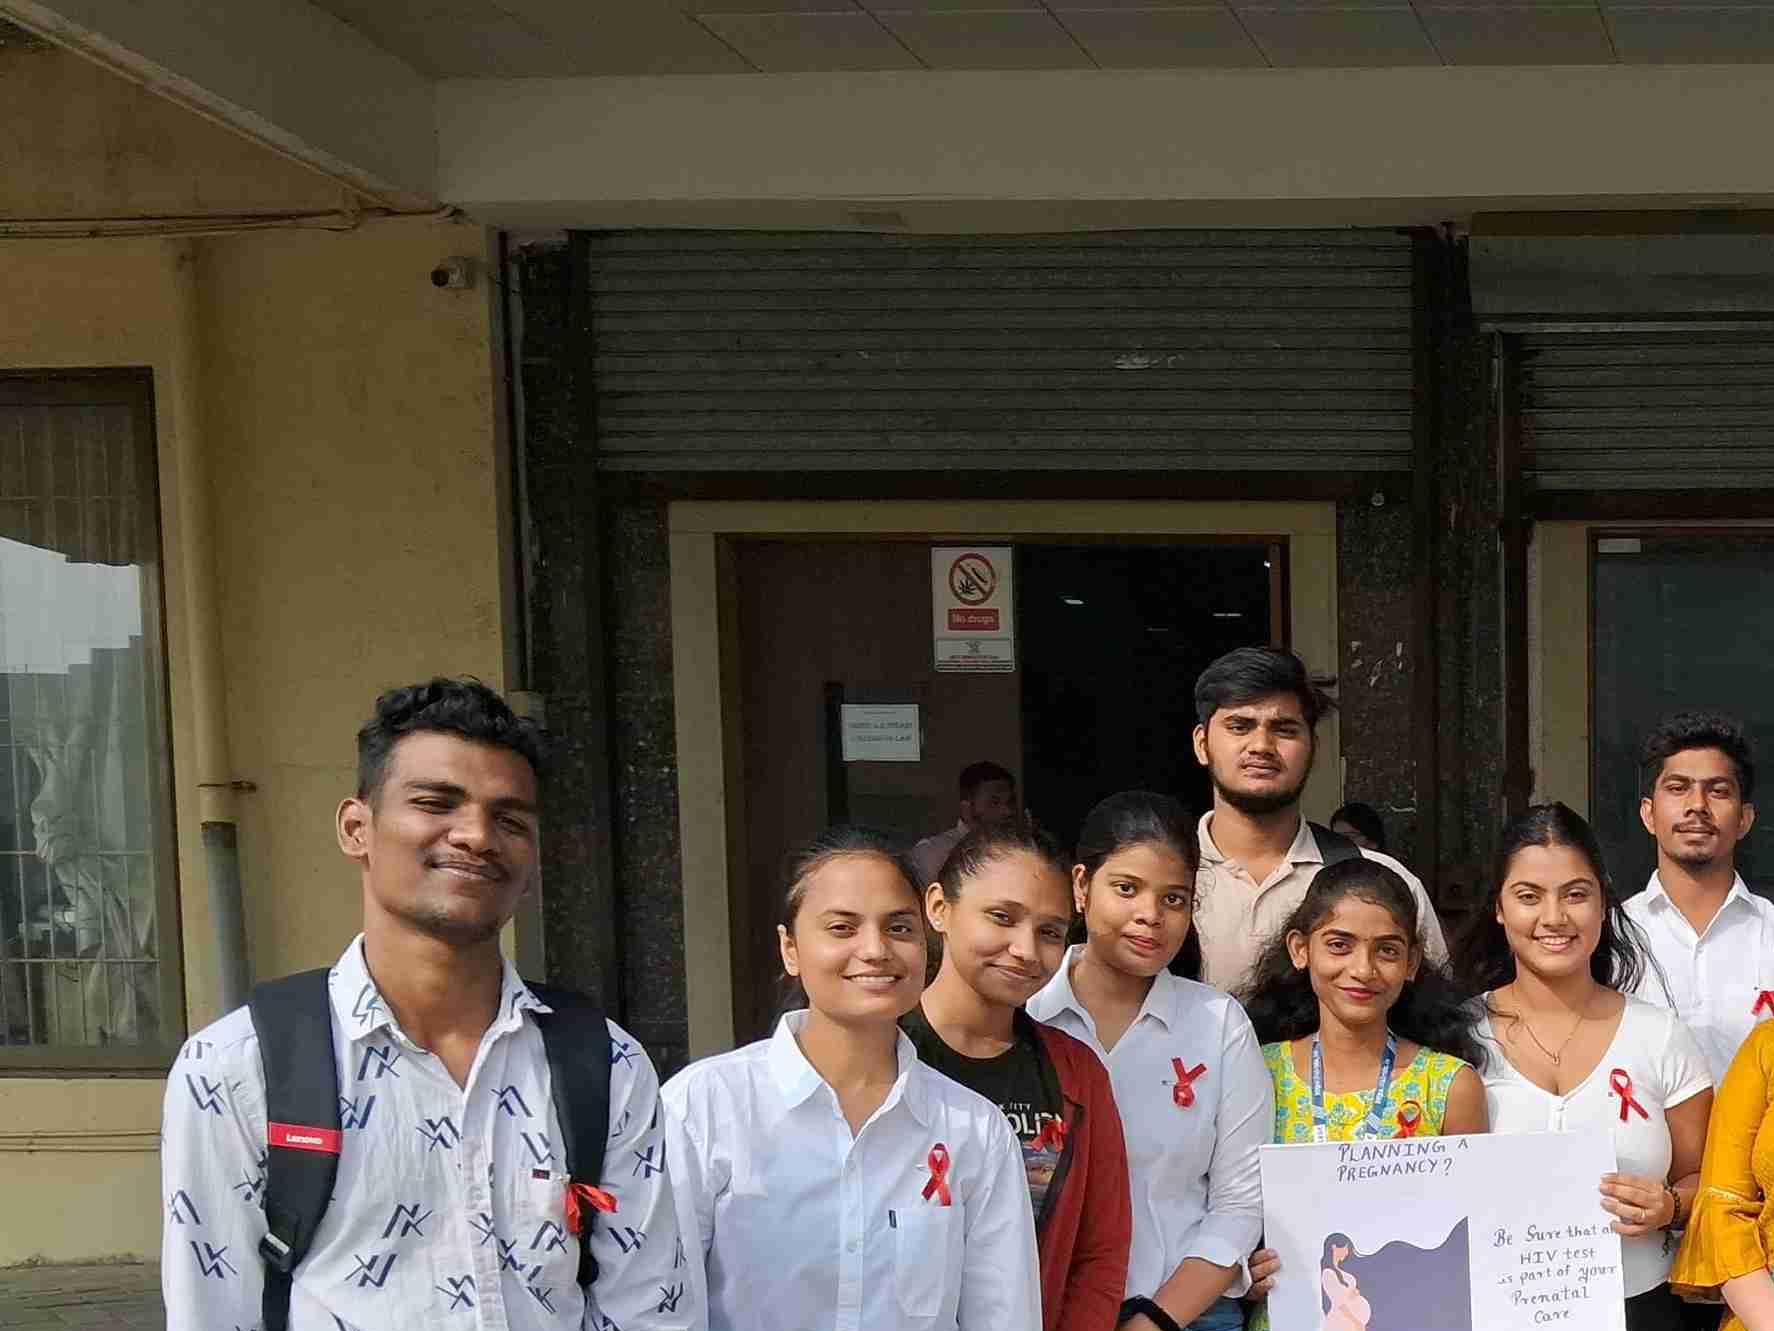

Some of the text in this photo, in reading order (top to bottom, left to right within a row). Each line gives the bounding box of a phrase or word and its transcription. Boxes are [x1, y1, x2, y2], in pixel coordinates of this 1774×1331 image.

[1337, 1138, 1469, 1163] PLANNING A
[1566, 1224, 1598, 1238] that
[1520, 1249, 1559, 1265] HIV
[1556, 1264, 1571, 1277] of
